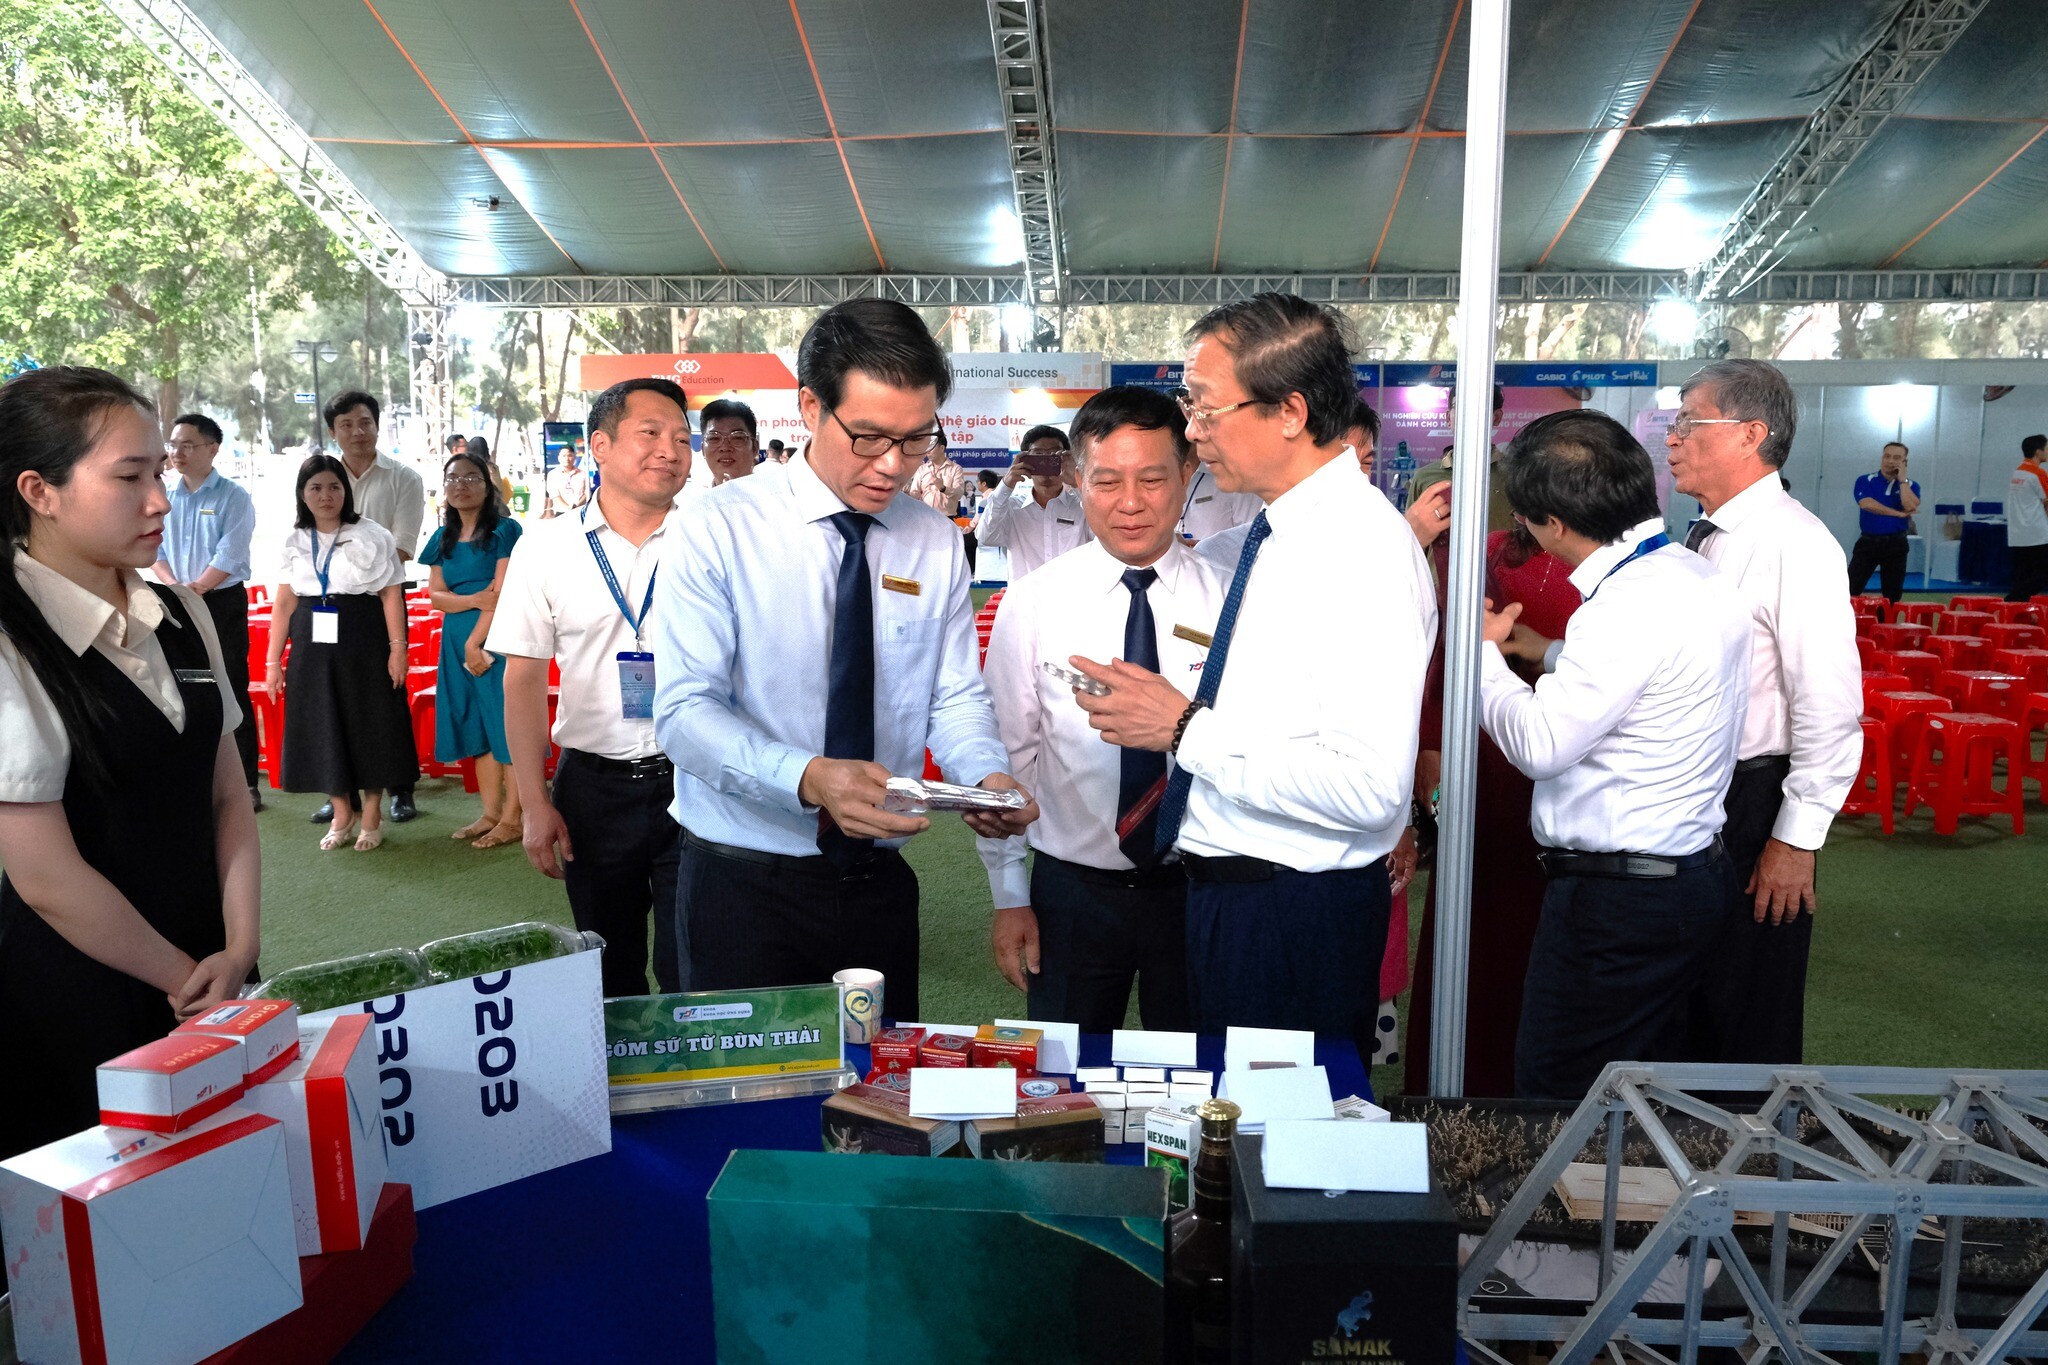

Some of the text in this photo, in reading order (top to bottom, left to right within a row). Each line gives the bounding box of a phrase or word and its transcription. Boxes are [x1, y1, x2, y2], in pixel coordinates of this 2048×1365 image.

[1007, 366, 1058, 379] Success
[1536, 373, 1567, 381] CASIO
[1581, 373, 1606, 381] PILOT
[682, 375, 725, 385] Education
[772, 417, 809, 430] phon
[966, 415, 997, 429] giáo
[1420, 420, 1438, 428] CHO
[951, 430, 974, 444] tập
[962, 450, 980, 458] pháp
[981, 450, 997, 458] giáo
[654, 1036, 682, 1054] SỨ
[687, 1034, 716, 1052] TỪ
[720, 1032, 765, 1050] BÙN
[770, 1025, 821, 1046] THẢI
[163, 1042, 220, 1067] Tissue
[1147, 1130, 1187, 1151] HEXSPAN
